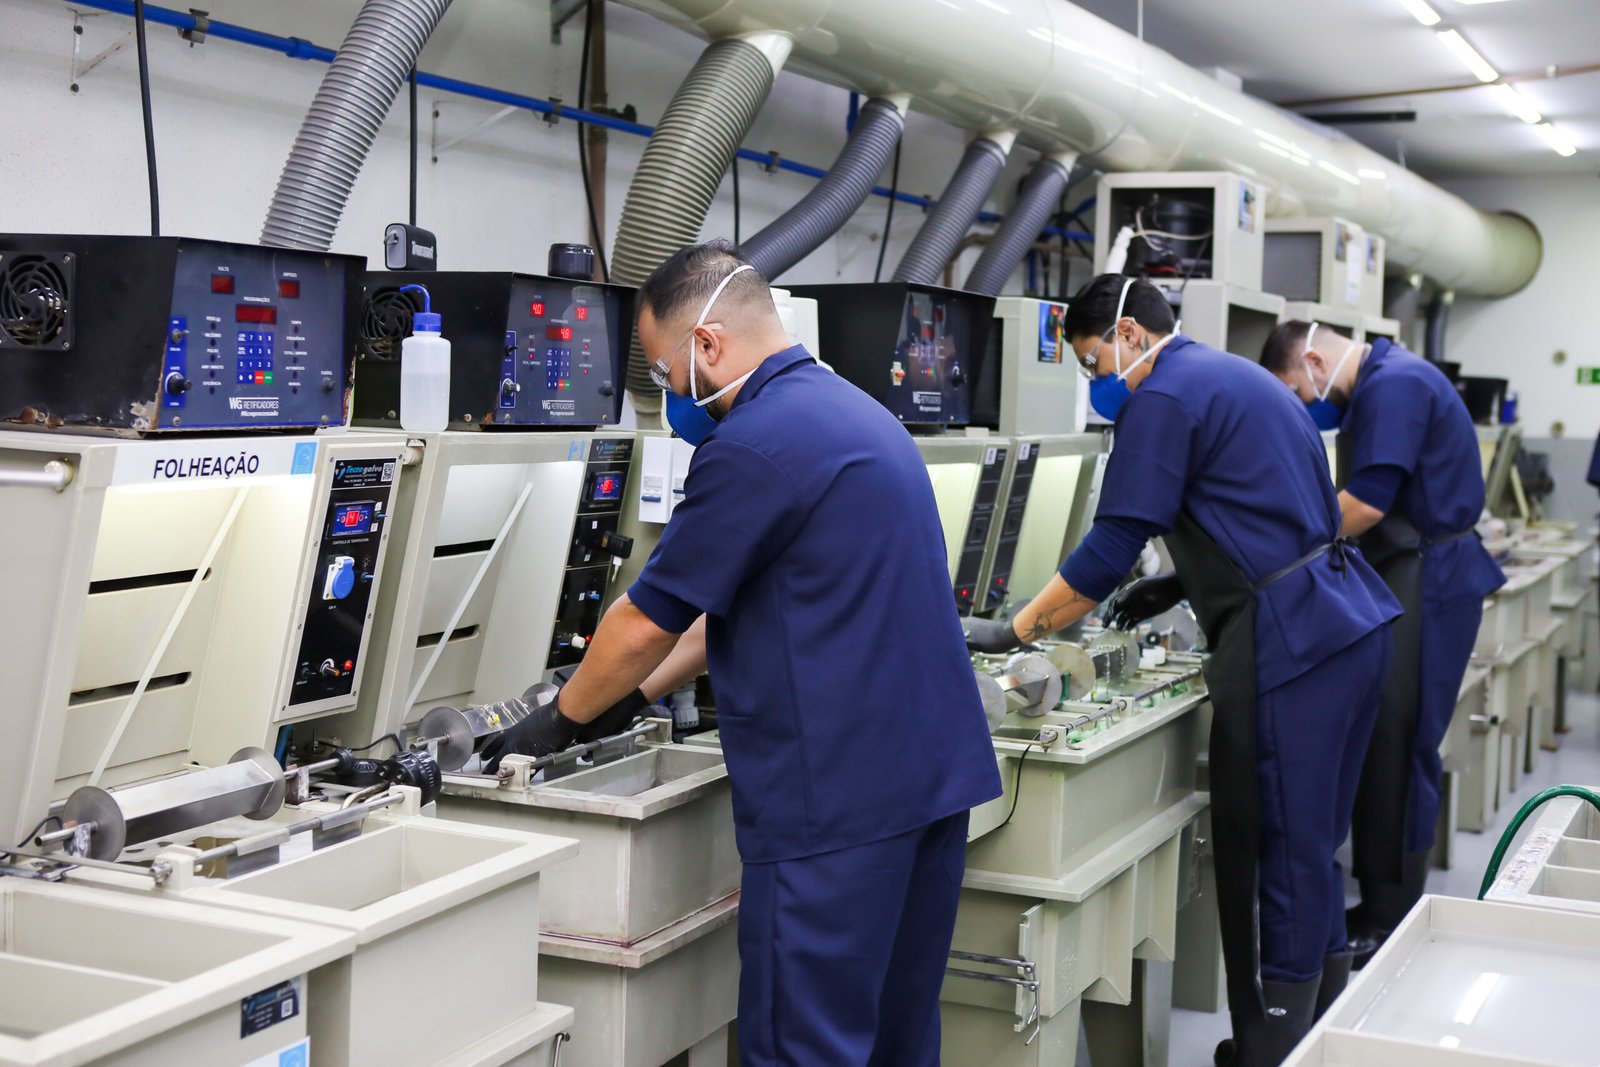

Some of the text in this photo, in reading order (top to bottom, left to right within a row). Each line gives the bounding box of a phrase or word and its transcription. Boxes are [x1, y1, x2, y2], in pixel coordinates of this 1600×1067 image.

[229, 397, 279, 410] WG RETIFICADORES
[241, 410, 279, 418] Microprocessado
[153, 451, 260, 480] FOLHEAÇÃO
